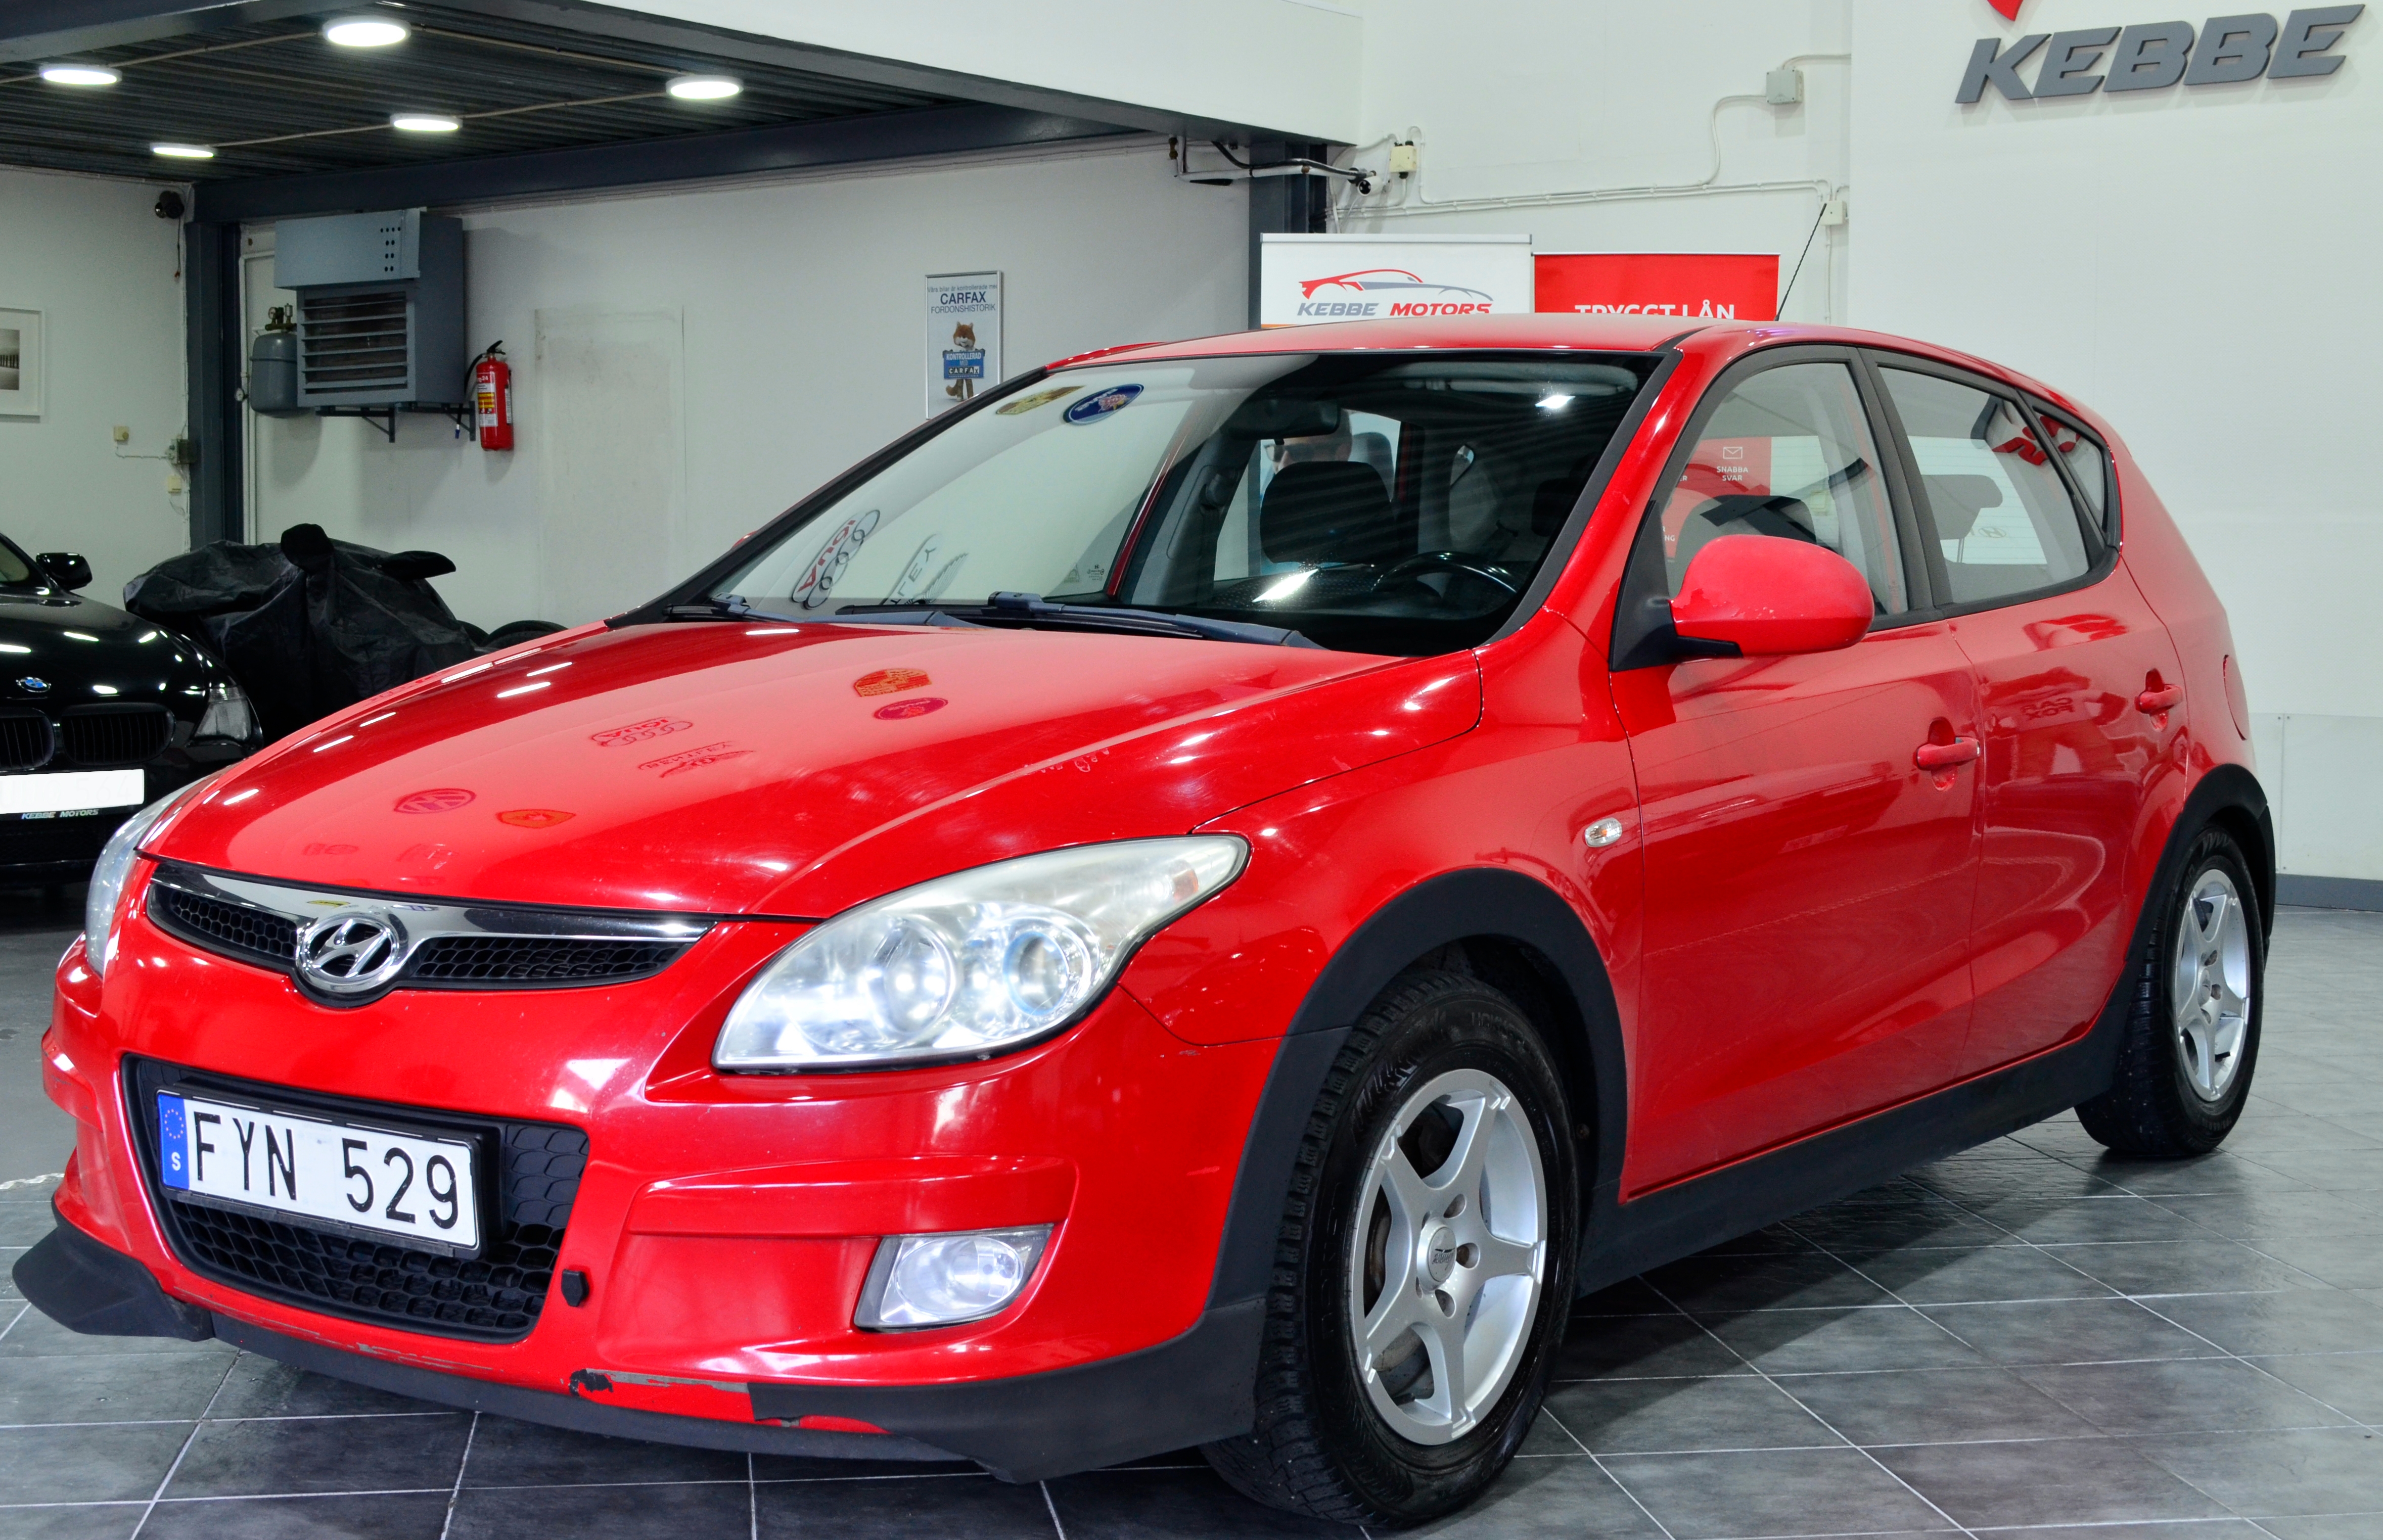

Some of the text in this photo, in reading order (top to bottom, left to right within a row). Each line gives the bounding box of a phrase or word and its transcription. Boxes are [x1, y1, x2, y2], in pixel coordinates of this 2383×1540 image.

[1955, 4, 2365, 104] KEBBE
[940, 291, 986, 305] CARFAX
[931, 304, 995, 313] FORDONSHISTORIK
[1297, 303, 1492, 316] KEBBE MOTORS
[946, 352, 981, 360] KONTROLLERAD
[60, 809, 99, 818] MOTORS
[171, 1151, 181, 1171] S
[194, 1111, 459, 1229] FYN 529
